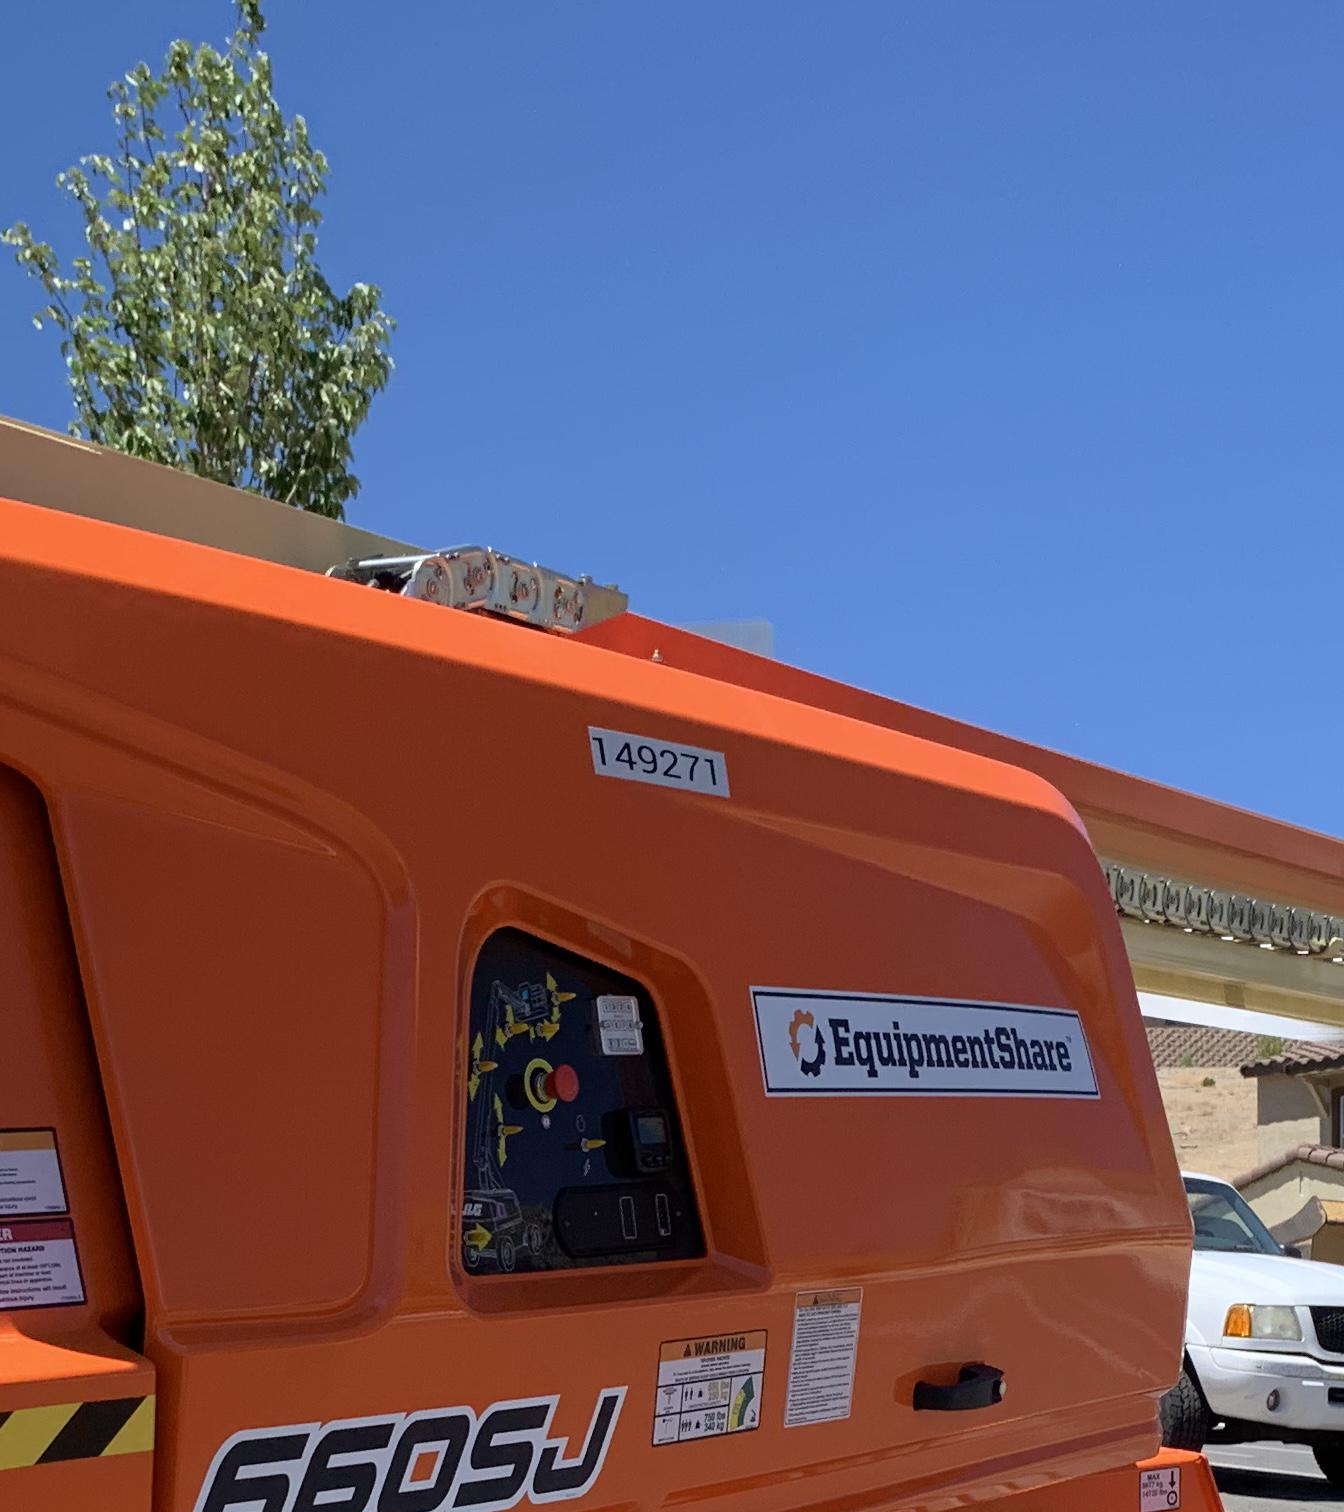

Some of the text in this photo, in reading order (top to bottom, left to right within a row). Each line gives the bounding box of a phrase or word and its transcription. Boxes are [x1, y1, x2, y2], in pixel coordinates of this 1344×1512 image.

[591, 737, 717, 786] 149271
[828, 1018, 1072, 1079] EquipmentShare
[694, 1337, 746, 1356] WARNING
